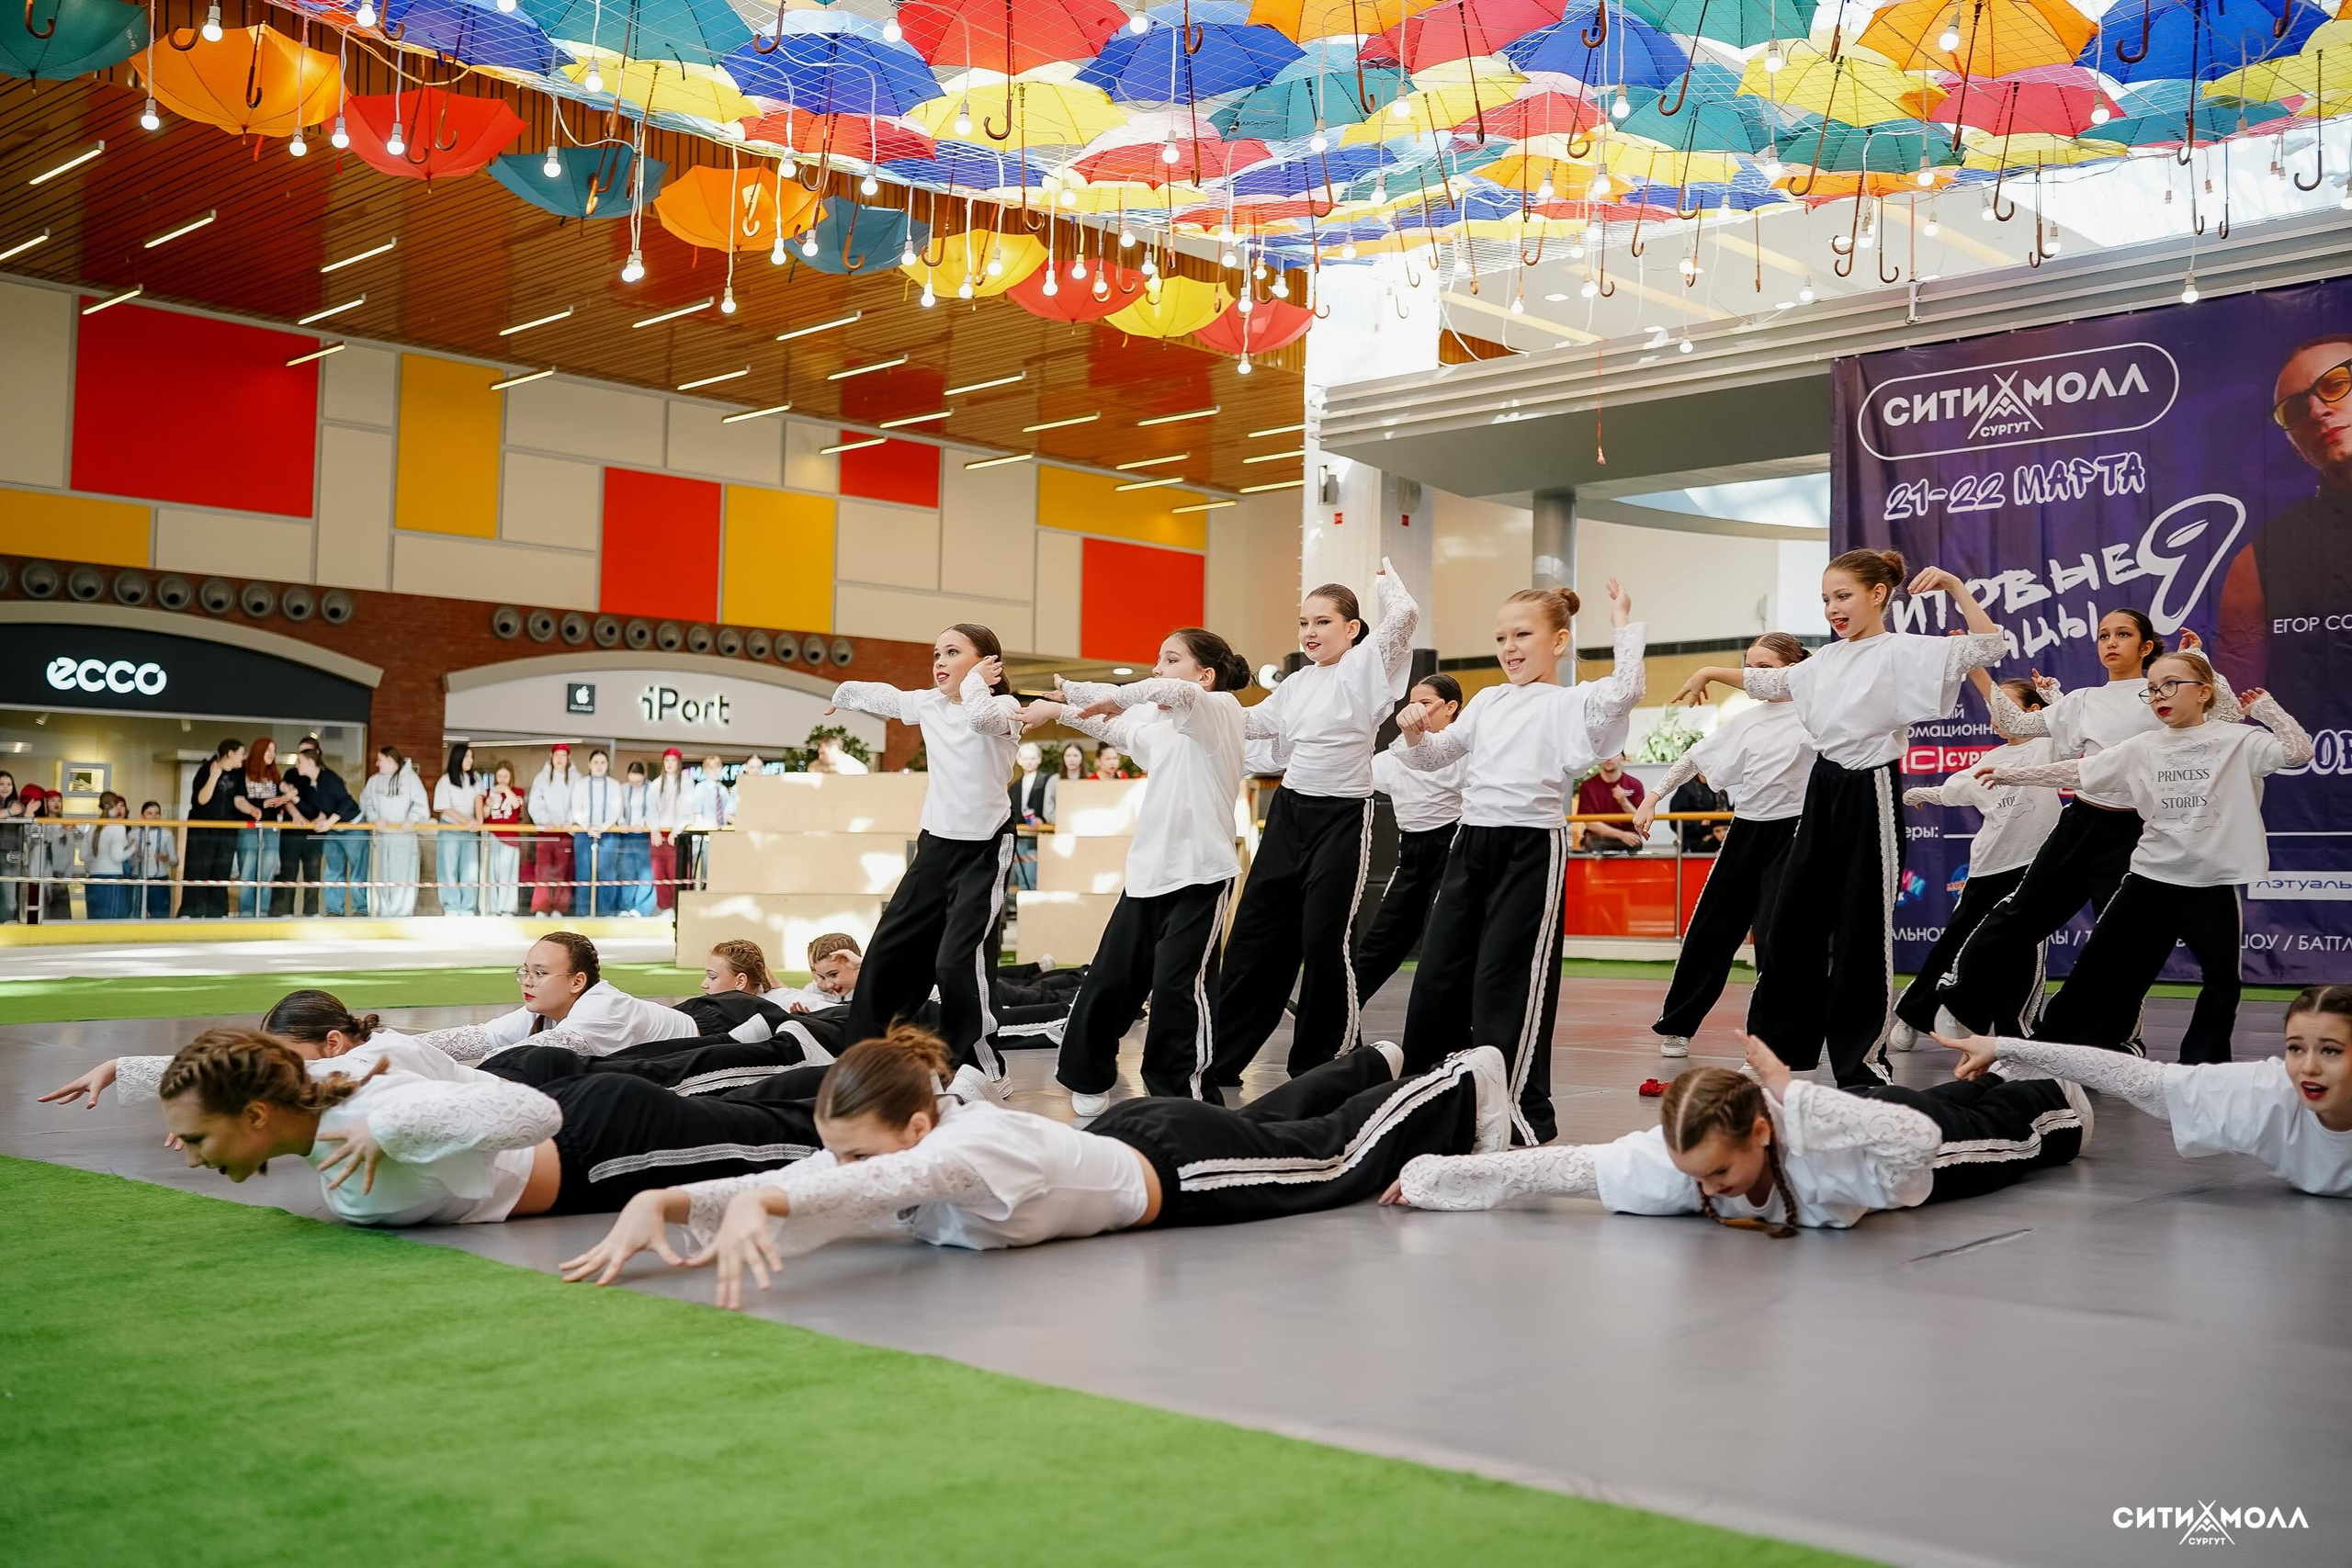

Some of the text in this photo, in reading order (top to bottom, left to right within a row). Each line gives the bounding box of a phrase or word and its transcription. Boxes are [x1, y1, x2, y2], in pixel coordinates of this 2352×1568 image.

[1883, 363, 2150, 426] СИТИ МОЛЛ
[1980, 421, 2030, 437] СУРГУТ
[1883, 452, 2145, 521] 21-22 МАРТА
[1893, 542, 2144, 635] ИТОВЫЕ
[2273, 616, 2320, 634] ЕГОР
[47, 657, 167, 695] ecco
[639, 685, 730, 724] iPort
[2157, 768, 2210, 783] PRINCESS
[2161, 795, 2208, 809] STORIES
[1905, 826, 1939, 841] еры:
